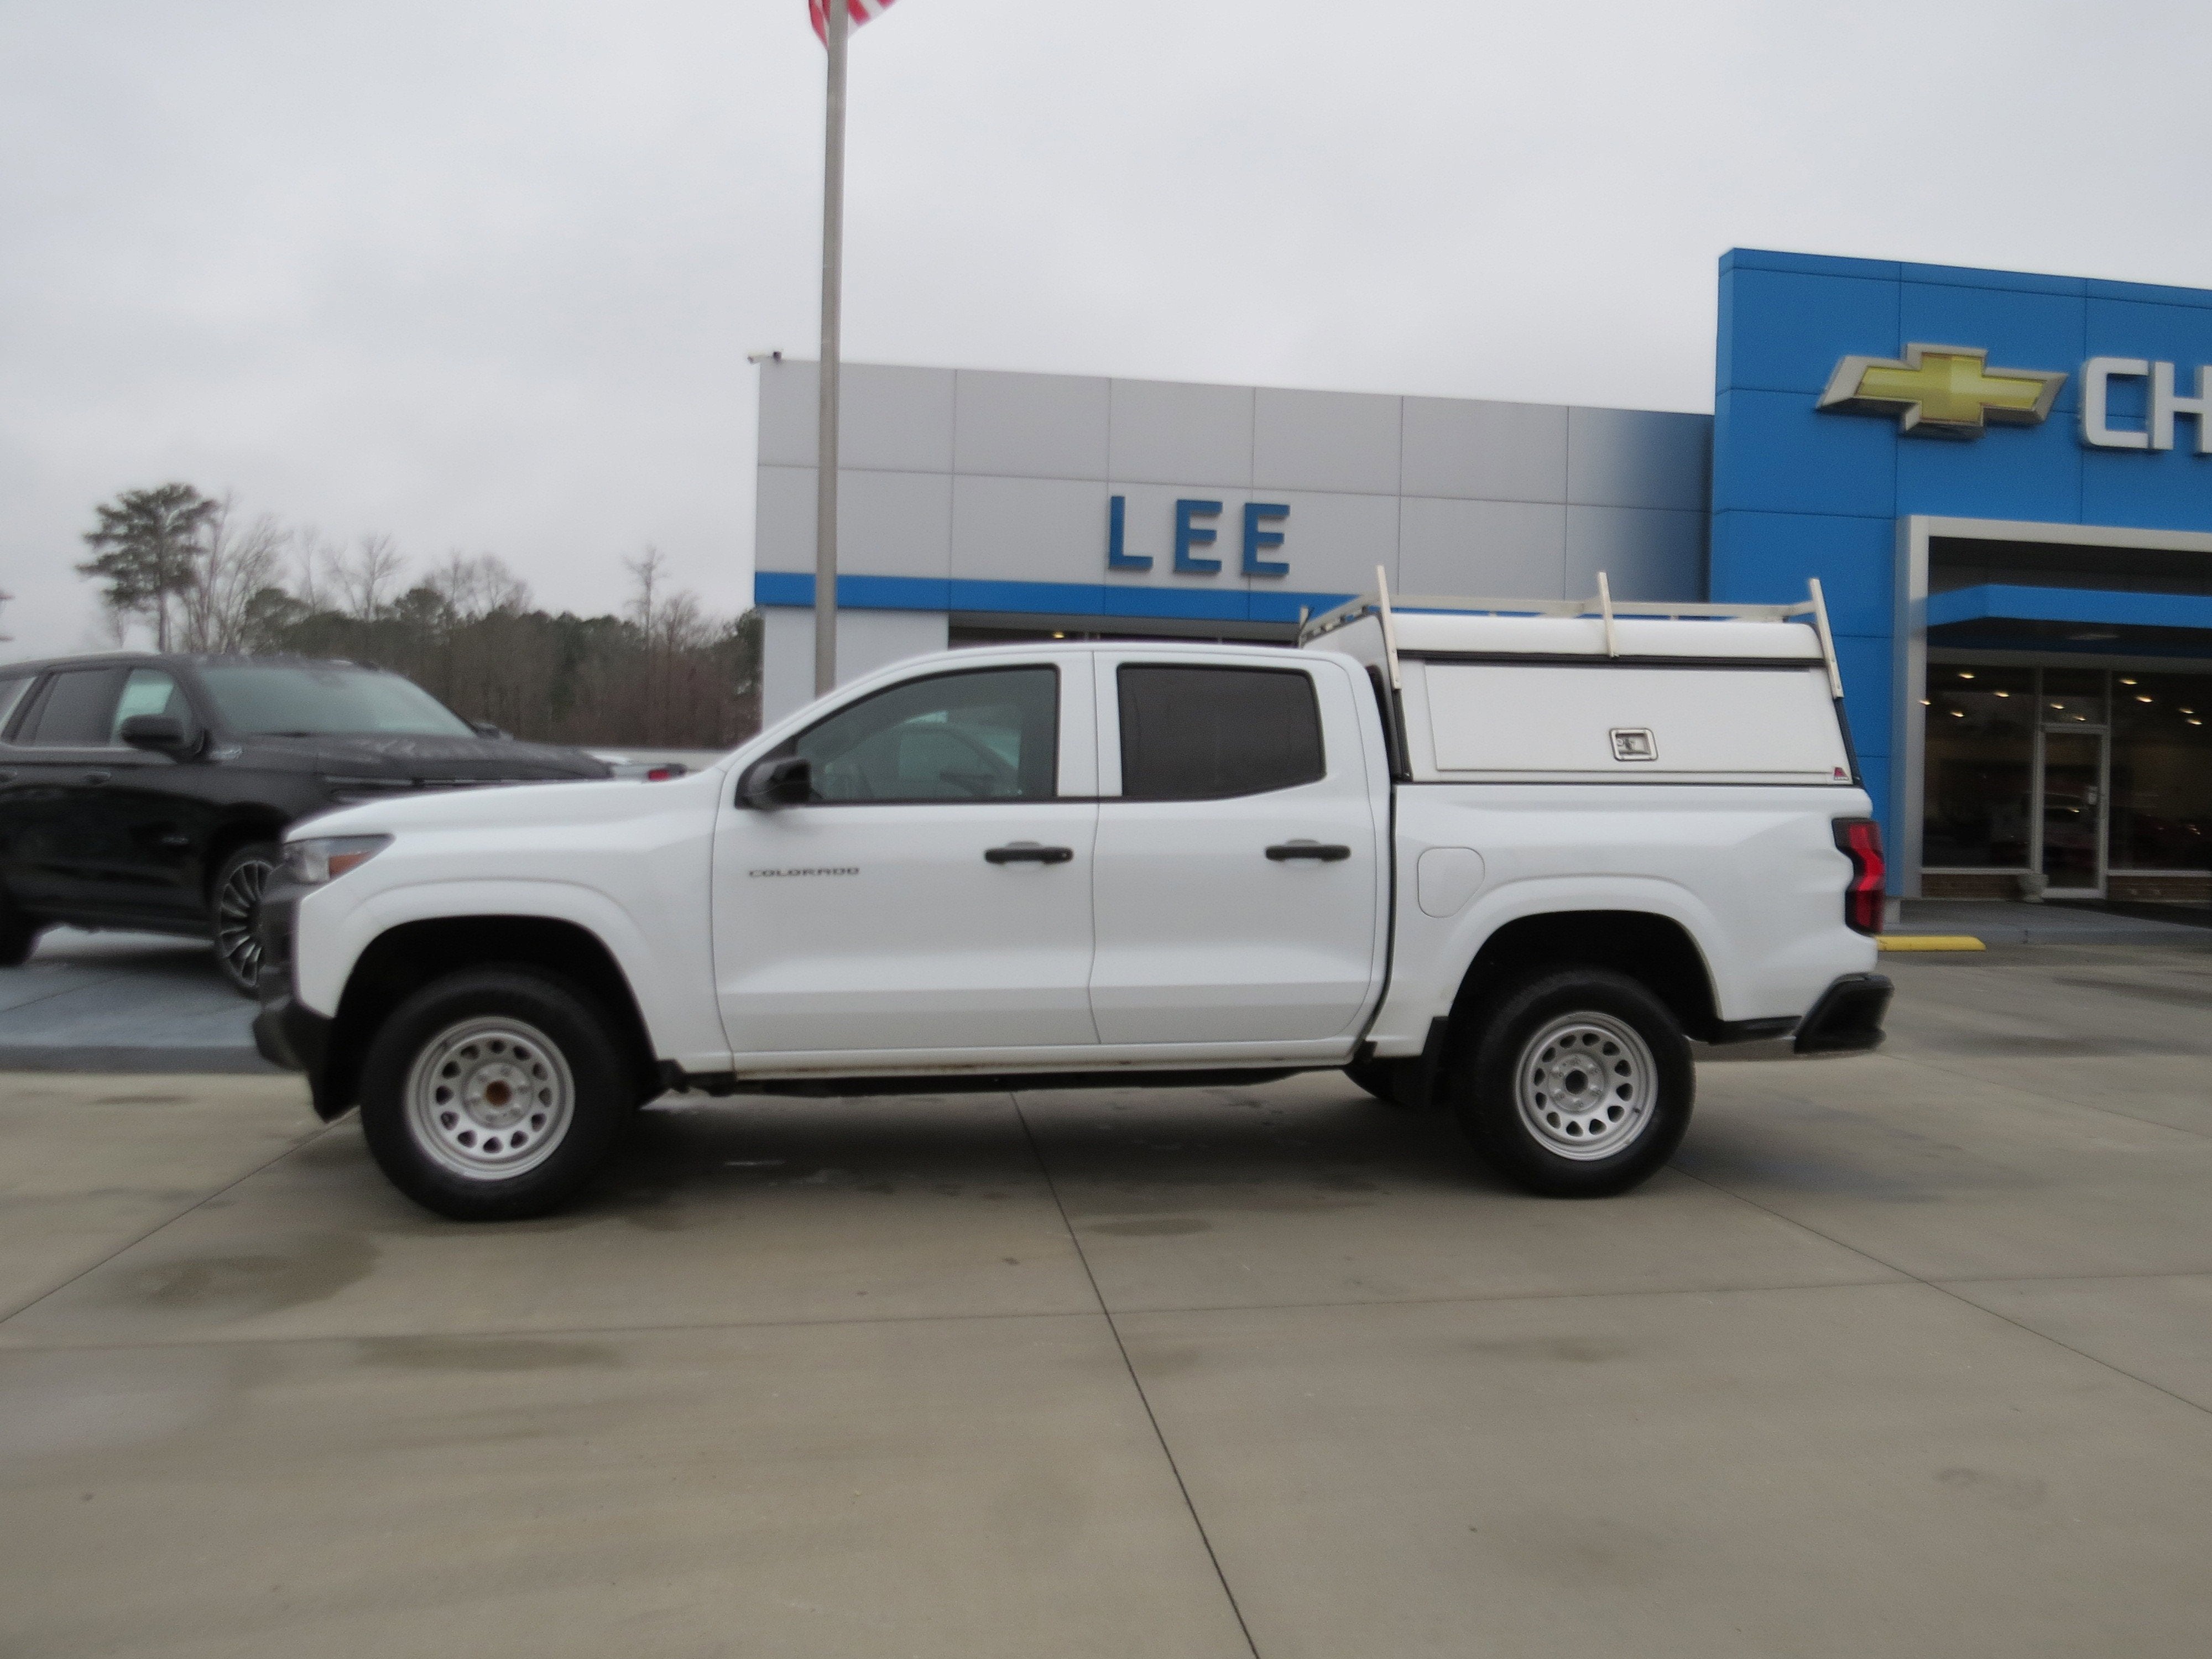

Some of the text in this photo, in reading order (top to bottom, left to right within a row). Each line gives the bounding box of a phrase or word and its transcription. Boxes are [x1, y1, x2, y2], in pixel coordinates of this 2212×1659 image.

[2080, 356, 2212, 453] CH
[1108, 495, 1291, 575] LEE
[749, 867, 860, 878] COLORADO
